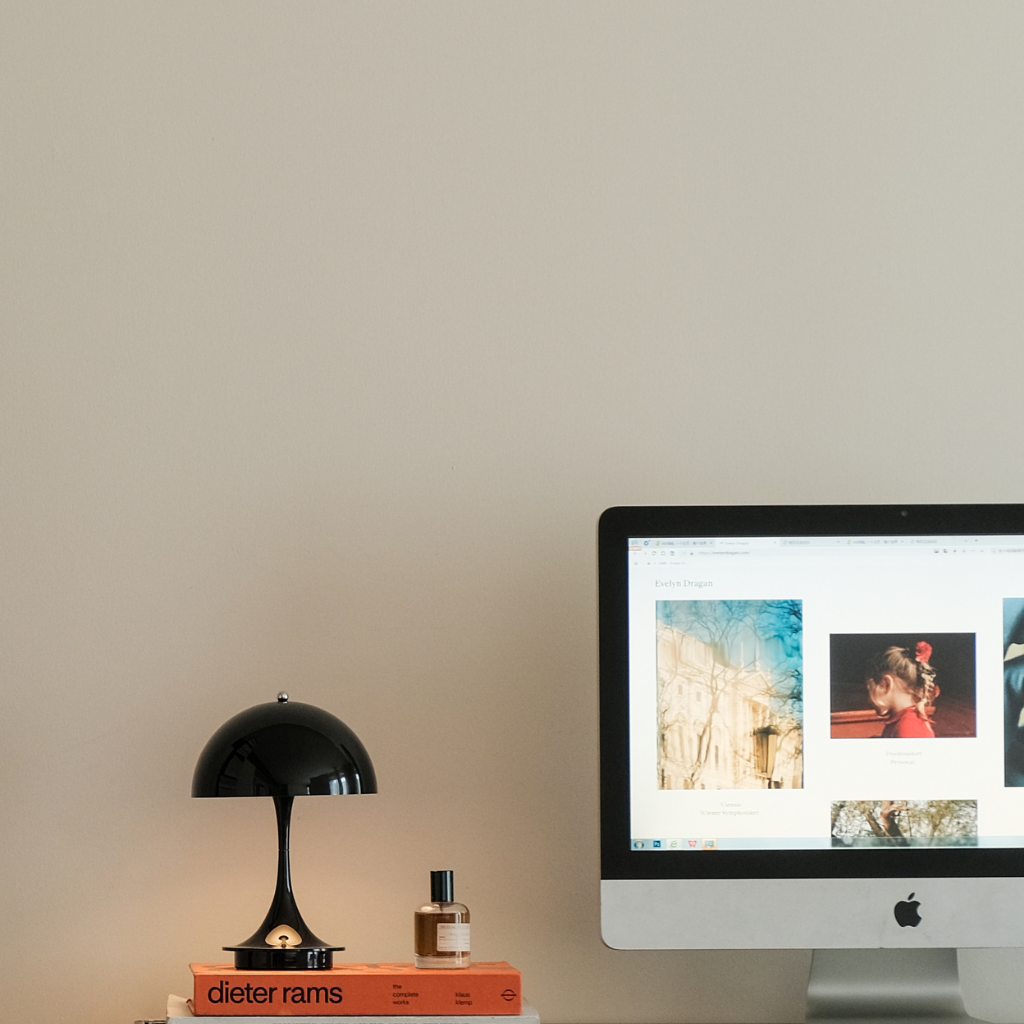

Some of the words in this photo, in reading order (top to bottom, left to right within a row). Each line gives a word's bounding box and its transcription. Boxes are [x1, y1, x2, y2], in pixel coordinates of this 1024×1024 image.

[655, 579, 682, 588] Evelyn
[683, 579, 713, 588] Dragan
[207, 980, 277, 1004] dieter
[282, 986, 343, 1004] rams
